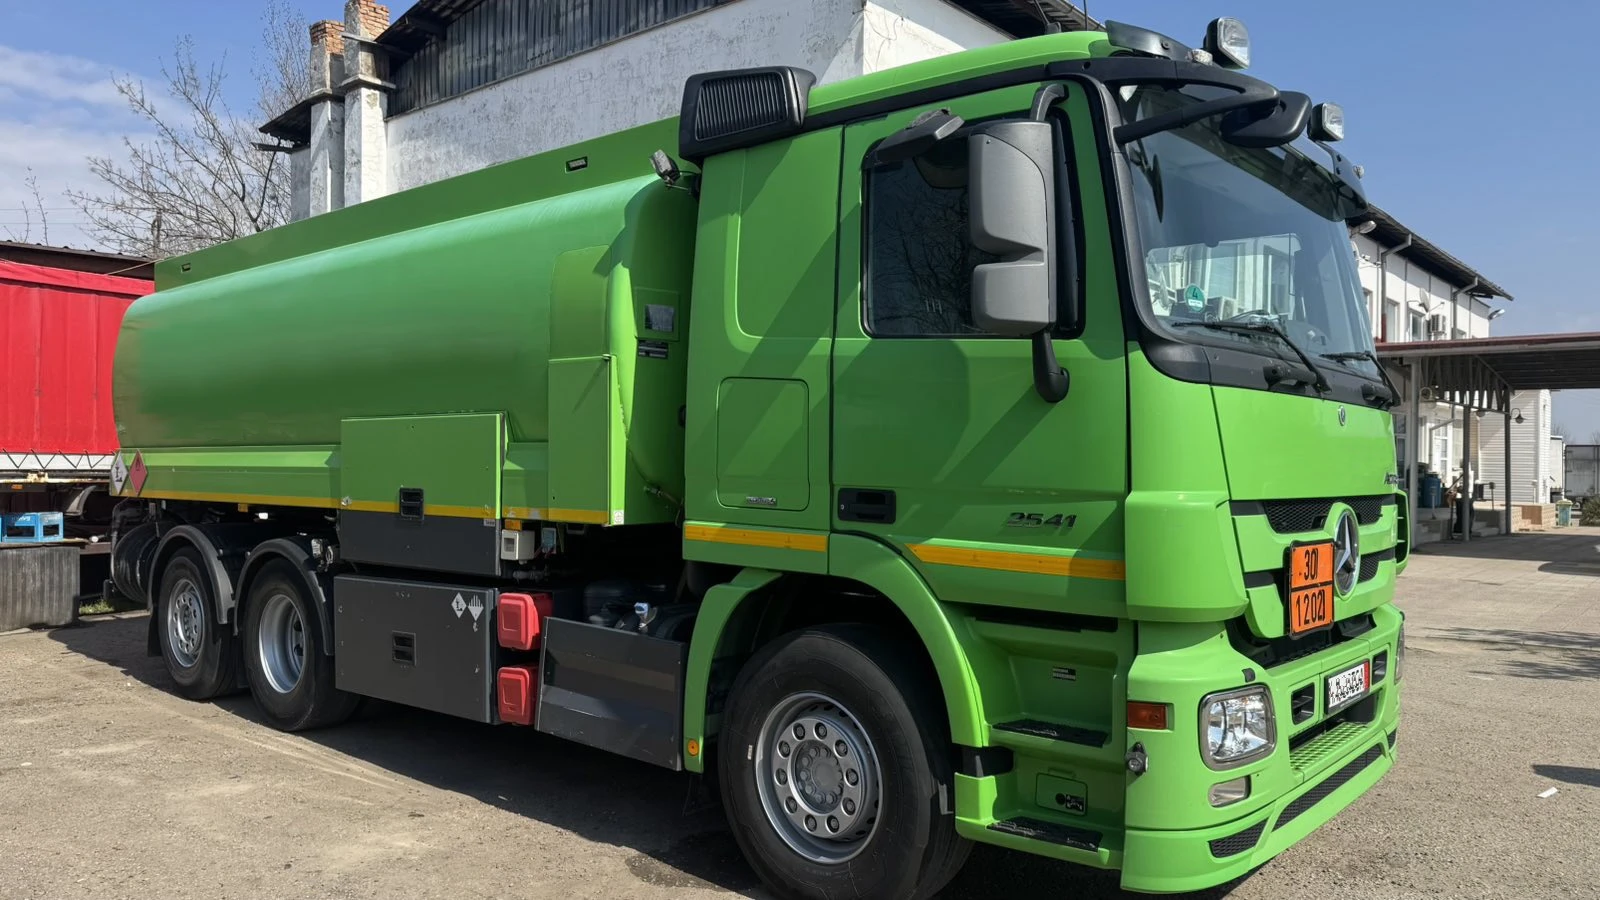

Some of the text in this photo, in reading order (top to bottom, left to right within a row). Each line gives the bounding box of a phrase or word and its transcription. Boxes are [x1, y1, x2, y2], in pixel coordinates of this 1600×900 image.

[1007, 512, 1077, 528] 2541
[1304, 547, 1318, 581] 30
[1296, 589, 1325, 627] 1202
